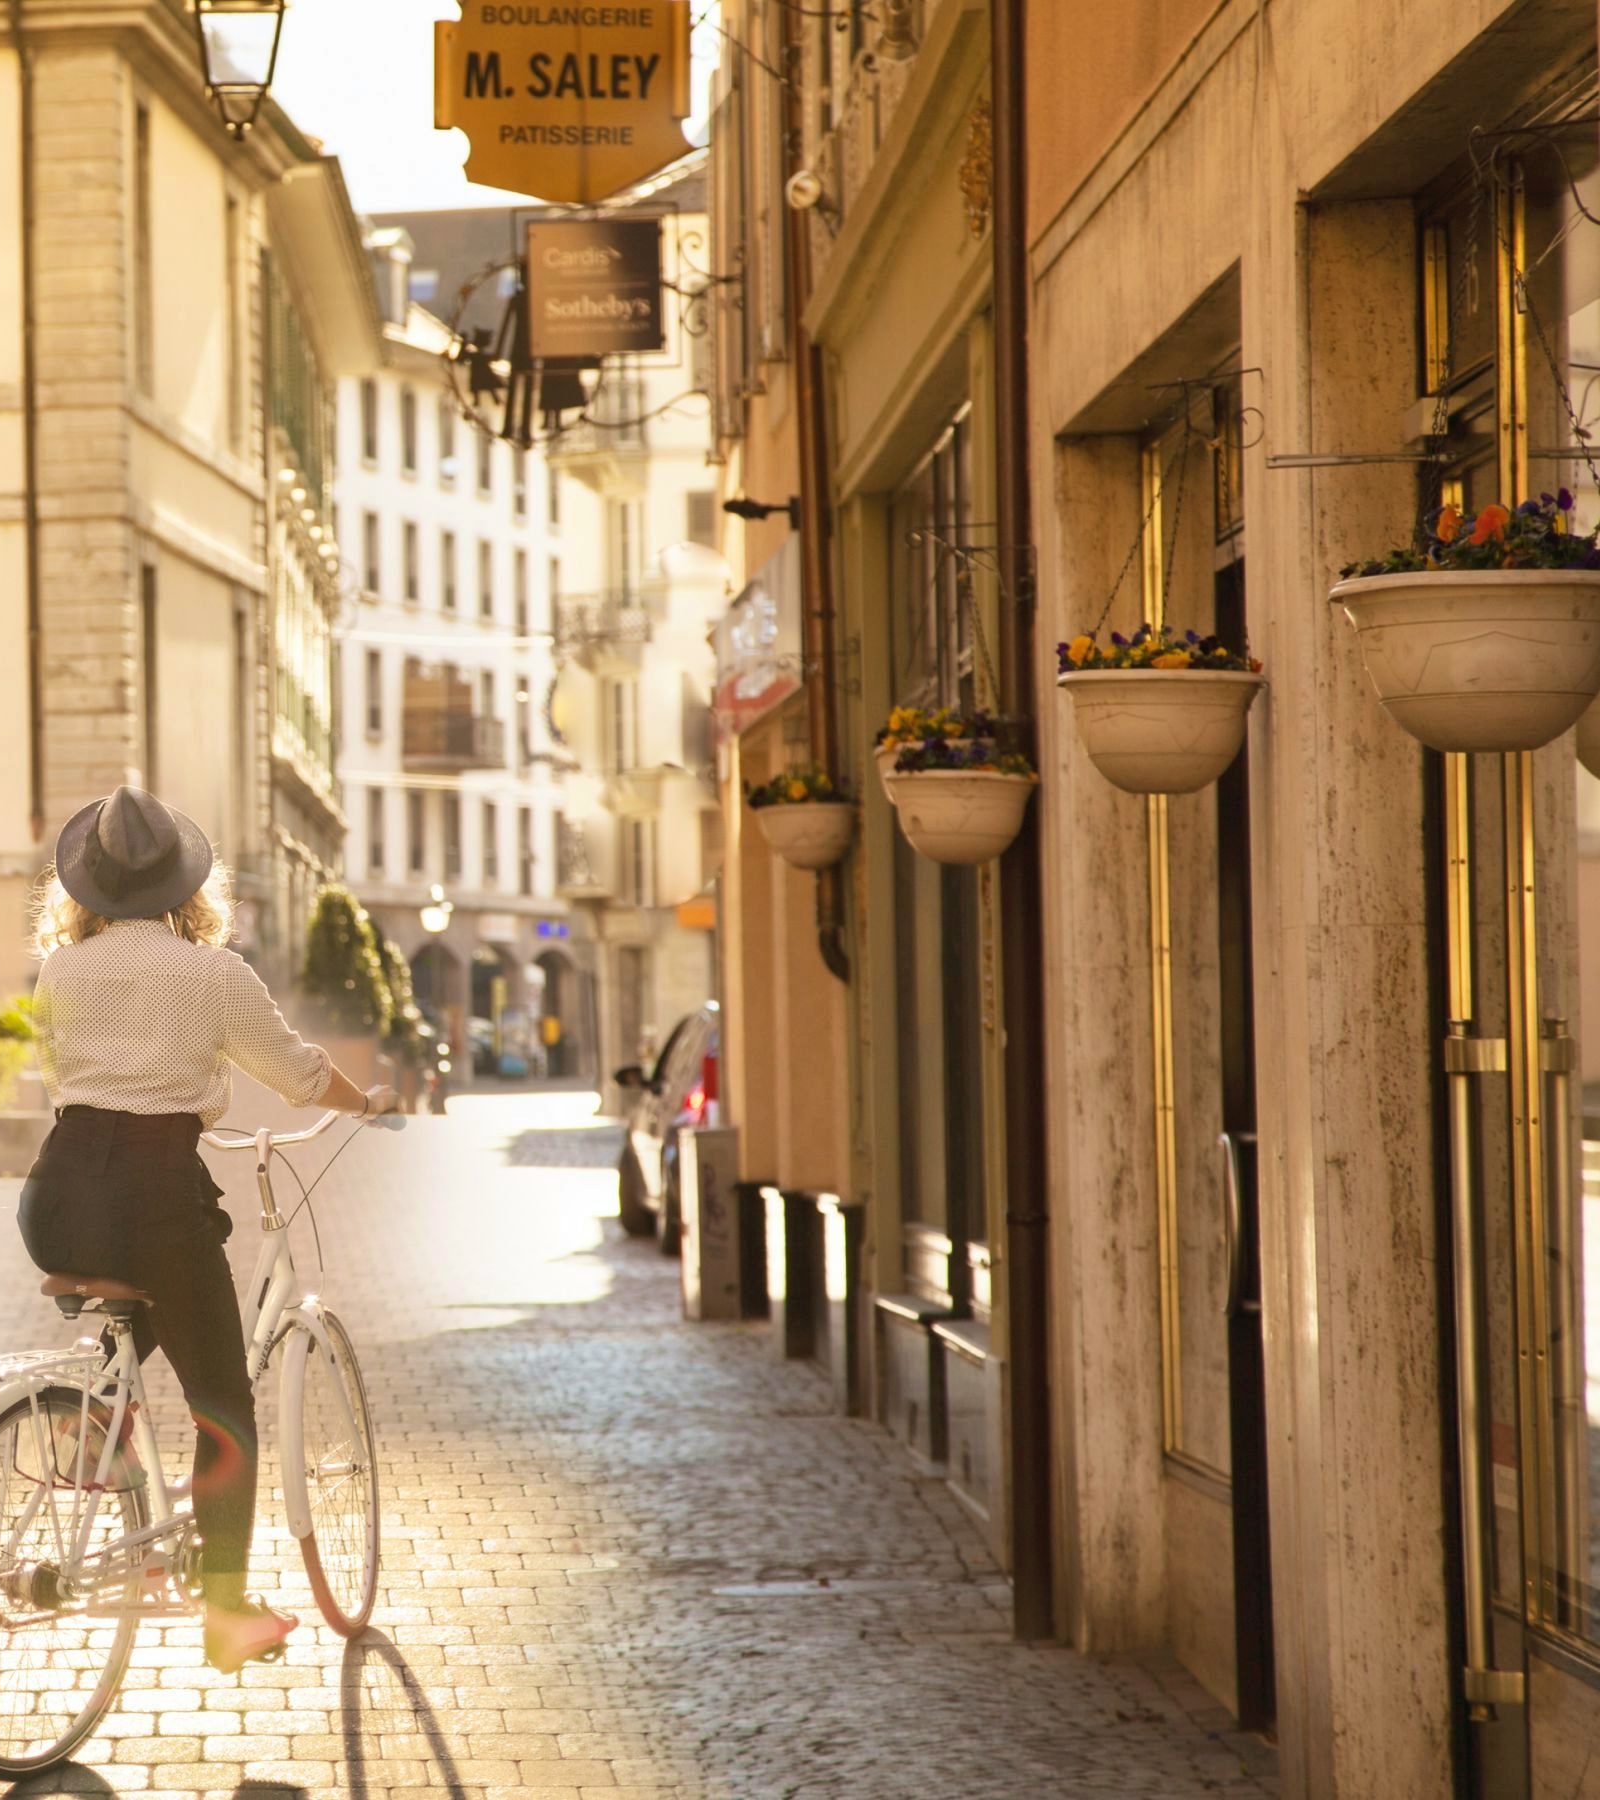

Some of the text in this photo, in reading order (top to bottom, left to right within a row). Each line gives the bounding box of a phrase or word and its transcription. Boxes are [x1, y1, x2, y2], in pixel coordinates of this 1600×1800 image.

[481, 5, 654, 28] BOULANGERIE
[464, 52, 661, 99] M. SALEY
[499, 125, 634, 146] PATISSERIE
[255, 1330, 275, 1382] MINERVA
